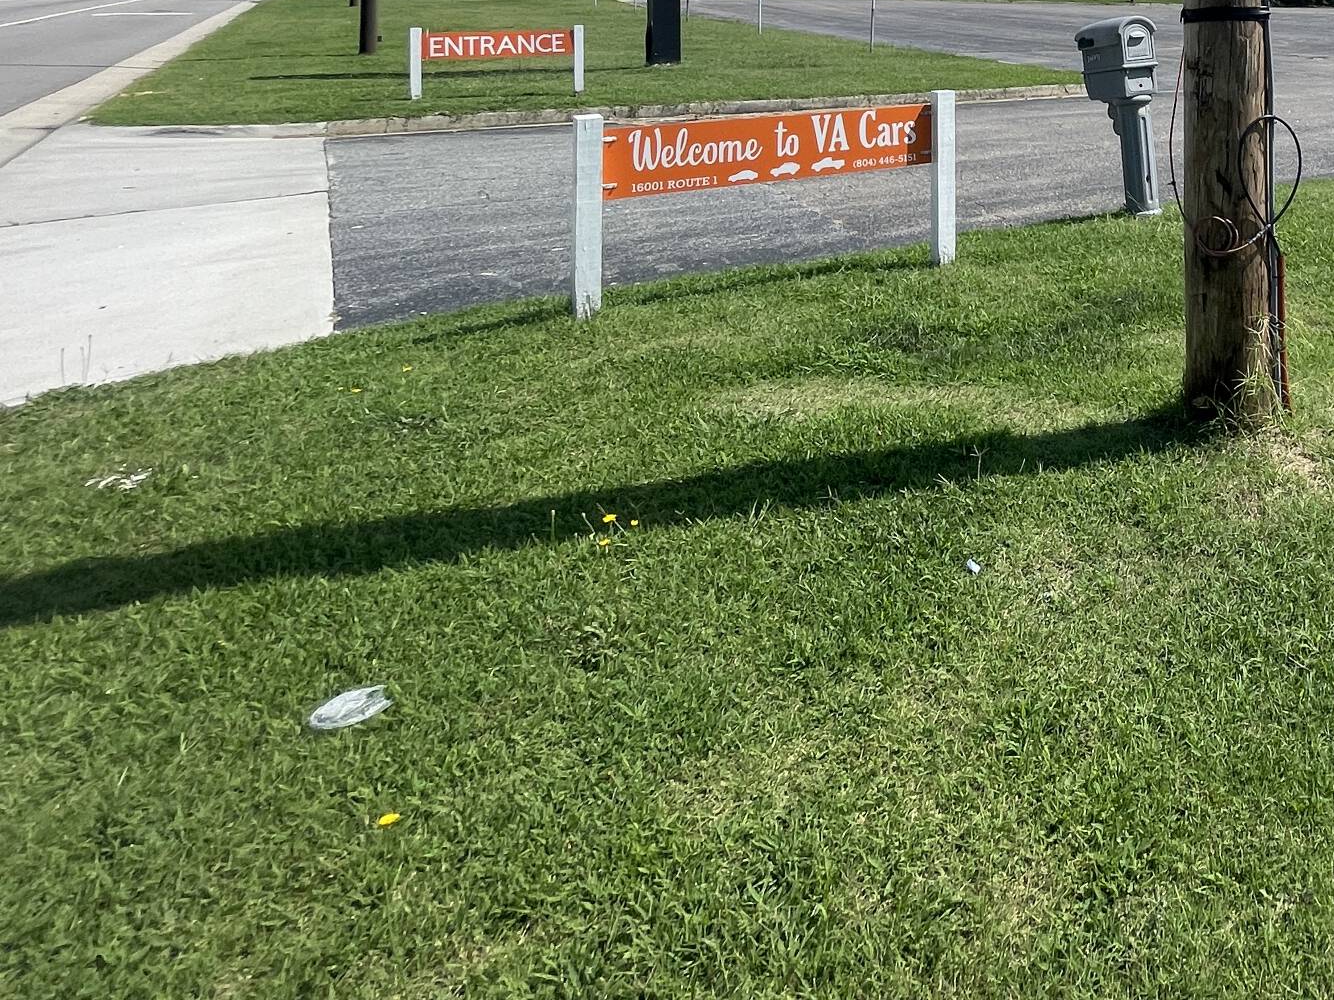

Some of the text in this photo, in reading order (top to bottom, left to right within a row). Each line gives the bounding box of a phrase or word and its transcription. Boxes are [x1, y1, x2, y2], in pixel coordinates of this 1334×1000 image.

[429, 33, 566, 58] ENTRANCE
[628, 110, 917, 173] Welcome to VA Cars
[852, 152, 918, 170] (804) 446-5151
[631, 175, 718, 194] 16001 ROUTE 1
